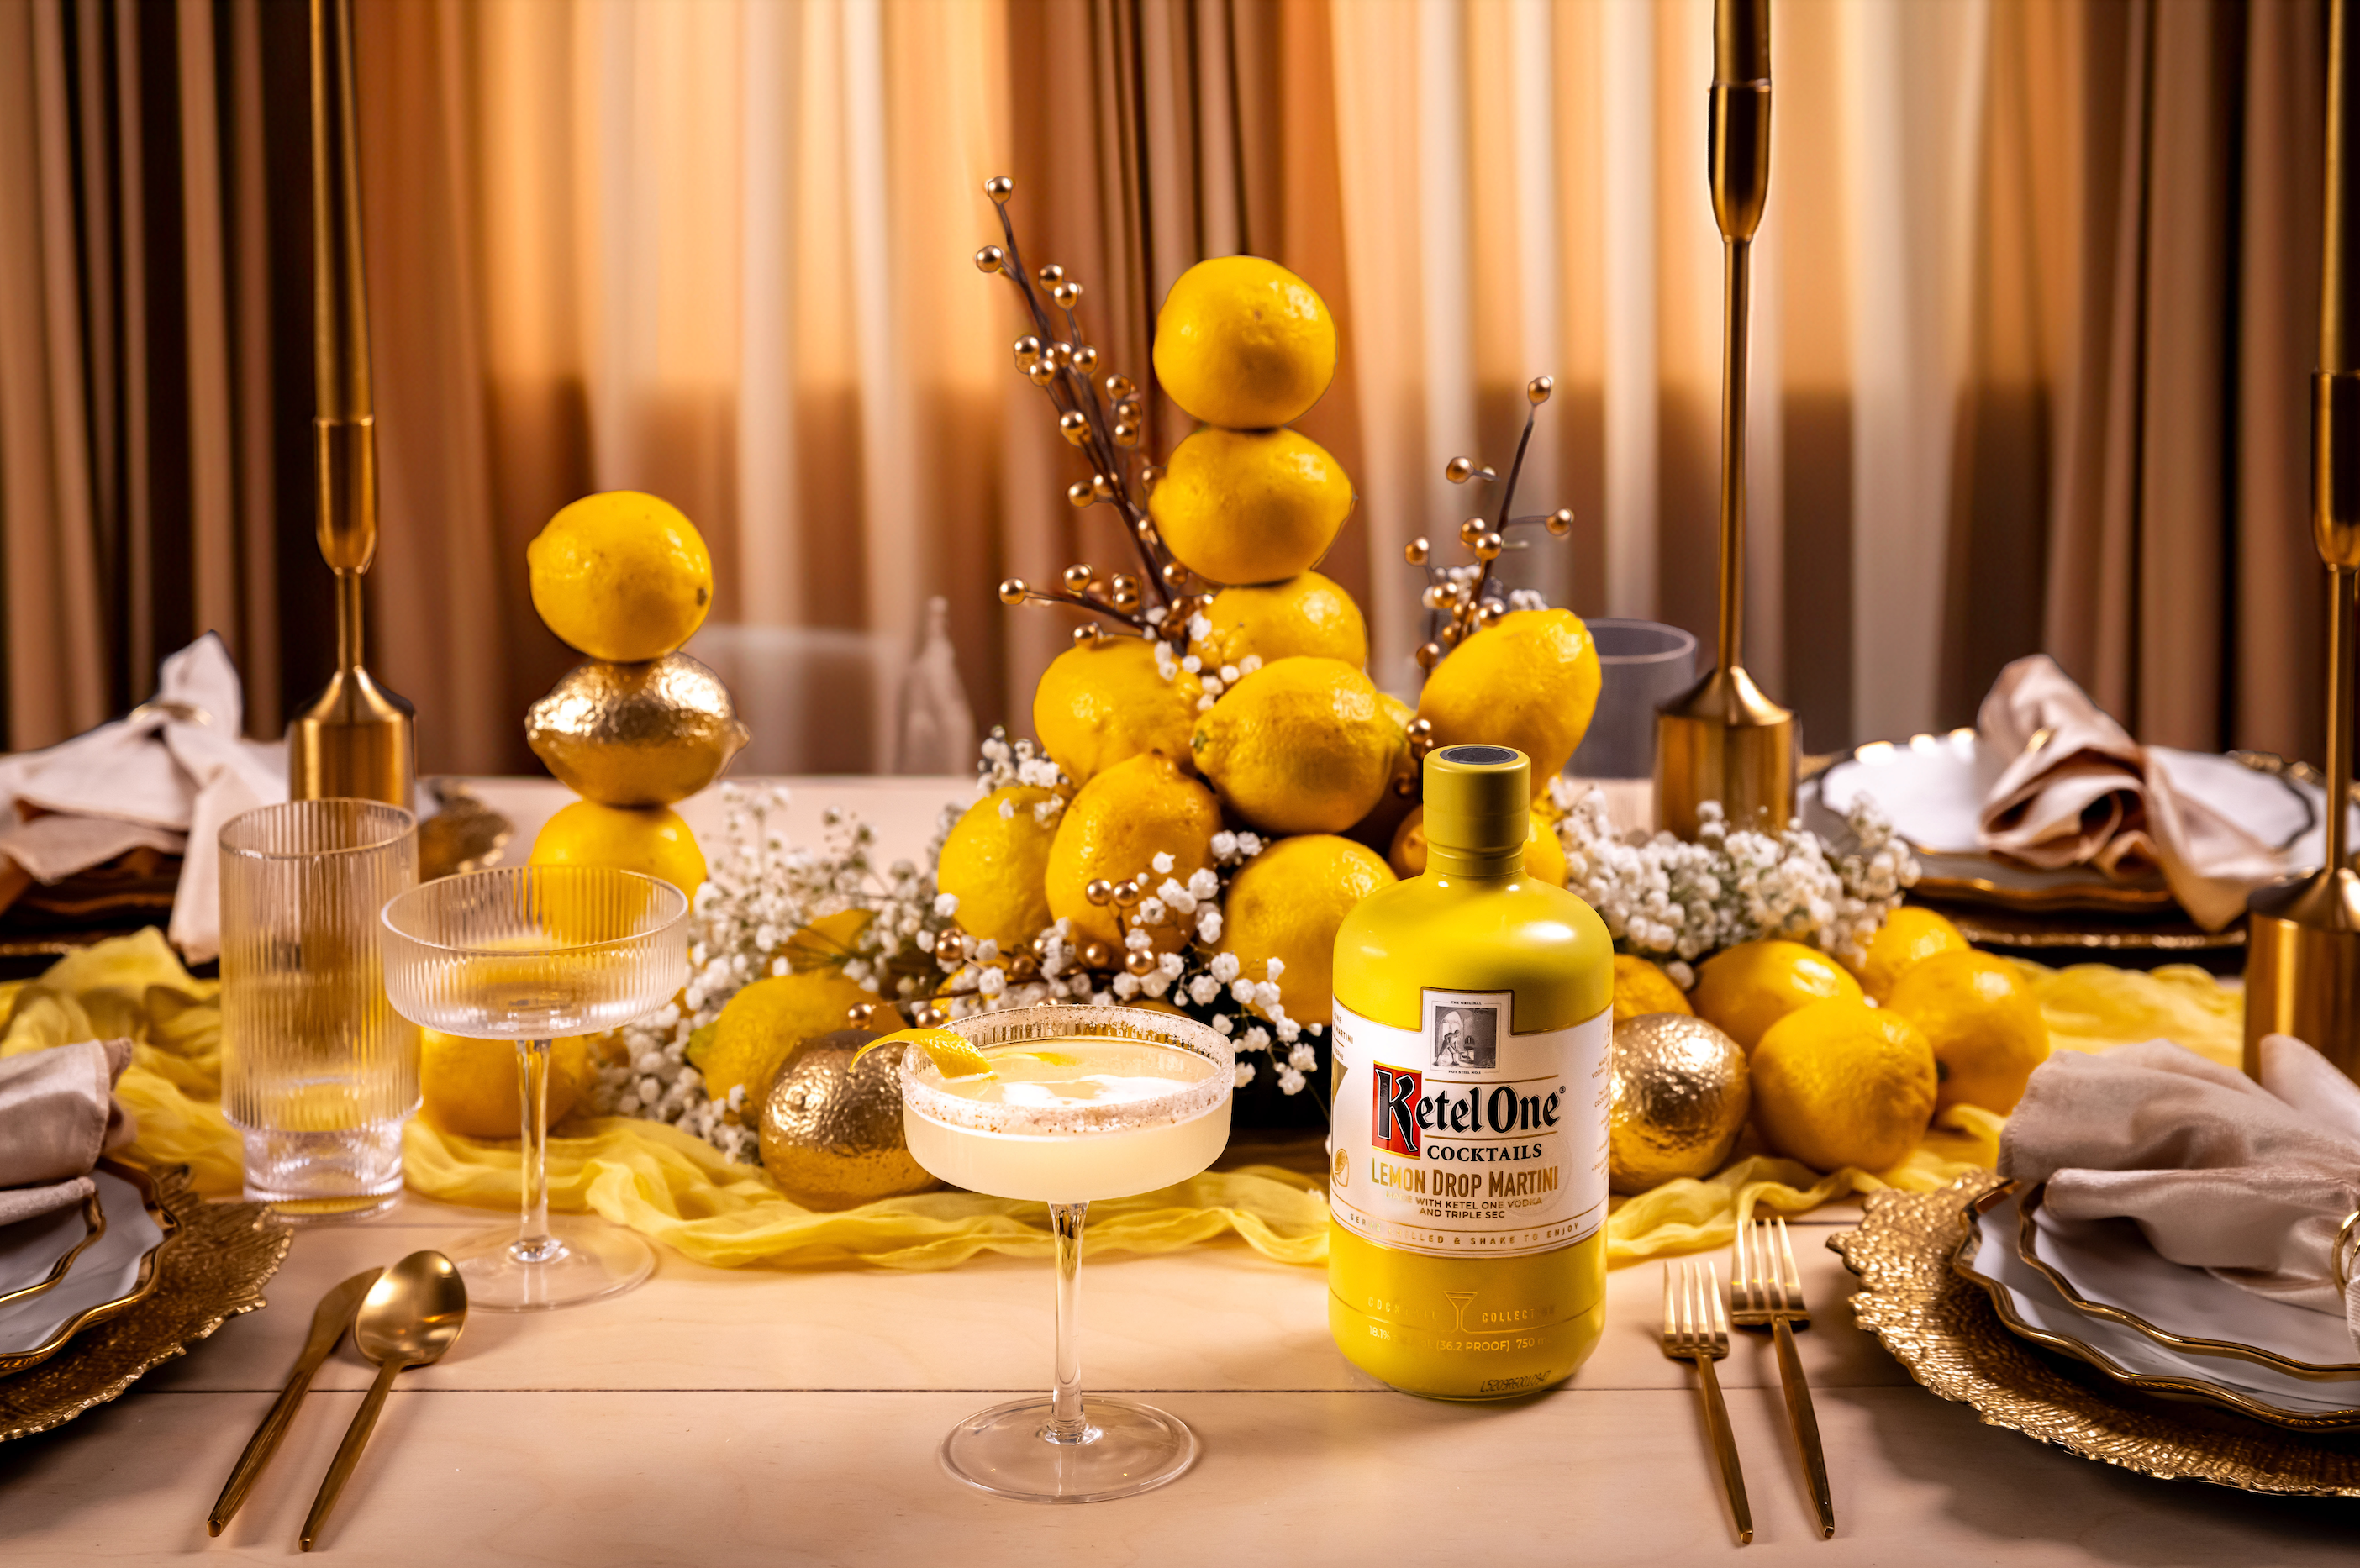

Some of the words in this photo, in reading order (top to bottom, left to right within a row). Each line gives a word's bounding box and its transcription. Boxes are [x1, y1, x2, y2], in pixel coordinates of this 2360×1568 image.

[1375, 1068, 1484, 1152] Ketel
[1427, 1143, 1542, 1162] COCKTAILS
[1372, 1157, 1426, 1194] LEMON
[1433, 1169, 1482, 1197] DROP
[1488, 1165, 1558, 1197] MARTINI
[1385, 1190, 1413, 1203] MADE
[1415, 1197, 1442, 1208] WITH
[1446, 1201, 1478, 1210] KETEL
[1481, 1201, 1504, 1210] ONE
[1507, 1197, 1543, 1208] VODKA
[1419, 1208, 1442, 1218] AND
[1445, 1210, 1482, 1219] TRIPLE
[1485, 1210, 1505, 1218] SEC
[1350, 1213, 1381, 1232] SERVE
[1388, 1228, 1444, 1244] CHILLED
[1470, 1235, 1515, 1245] SHAKE
[1524, 1233, 1538, 1243] TO
[1546, 1222, 1579, 1239] ENJOY
[1482, 1306, 1554, 1323] COLLECT
[1369, 1324, 1391, 1341] 18.1%
[1436, 1339, 1462, 1351] (36.2
[1466, 1339, 1510, 1352] PROOF)
[1516, 1337, 1535, 1349] 750
